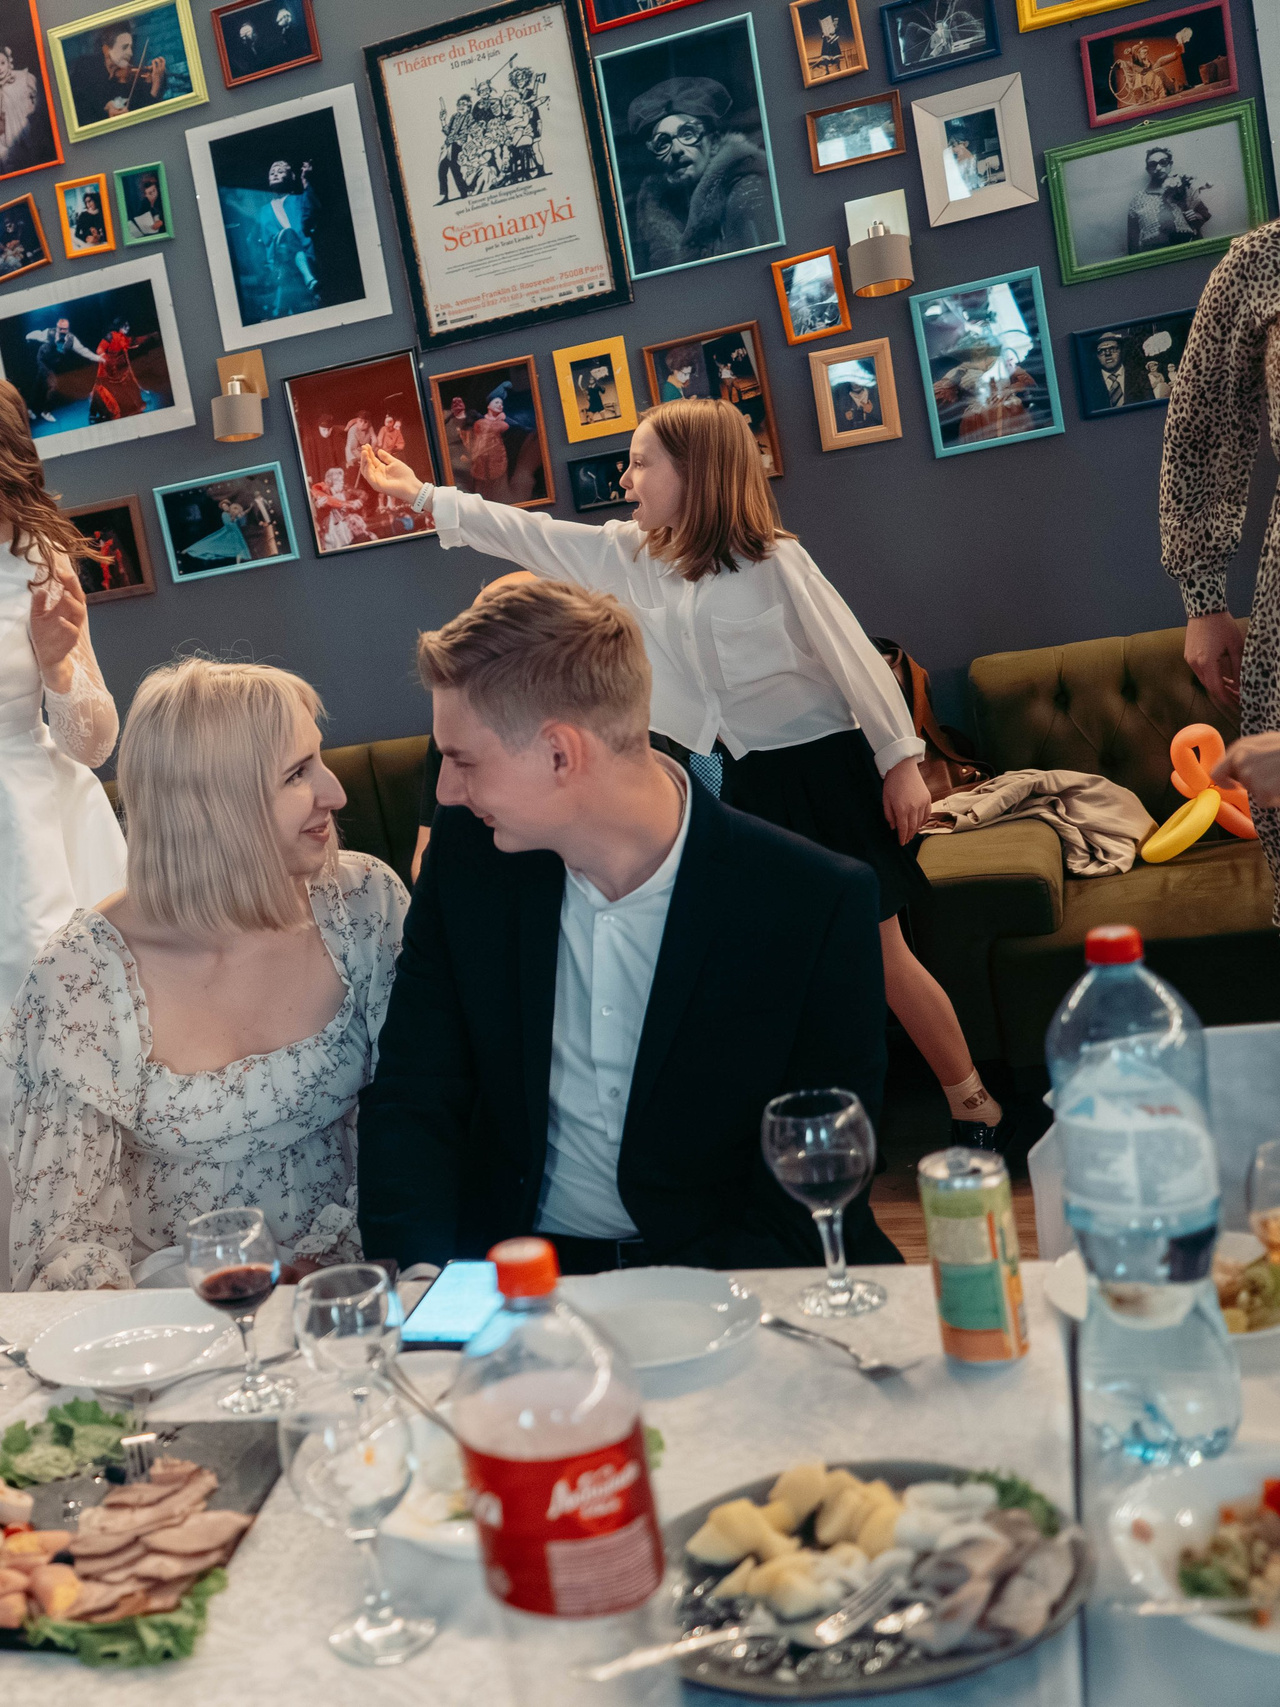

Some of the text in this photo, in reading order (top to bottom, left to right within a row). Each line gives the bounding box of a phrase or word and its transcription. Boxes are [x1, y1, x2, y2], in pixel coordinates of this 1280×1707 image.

[393, 52, 446, 76] Théâtre
[448, 44, 467, 60] du
[467, 22, 543, 53] Rond-Point
[450, 60, 460, 70] 10
[487, 49, 501, 61] juin
[442, 196, 577, 252] Semianyki
[481, 286, 511, 300] Franklin
[519, 275, 556, 290] Roosevelt
[559, 267, 584, 280] 75008
[584, 264, 605, 274] Paris
